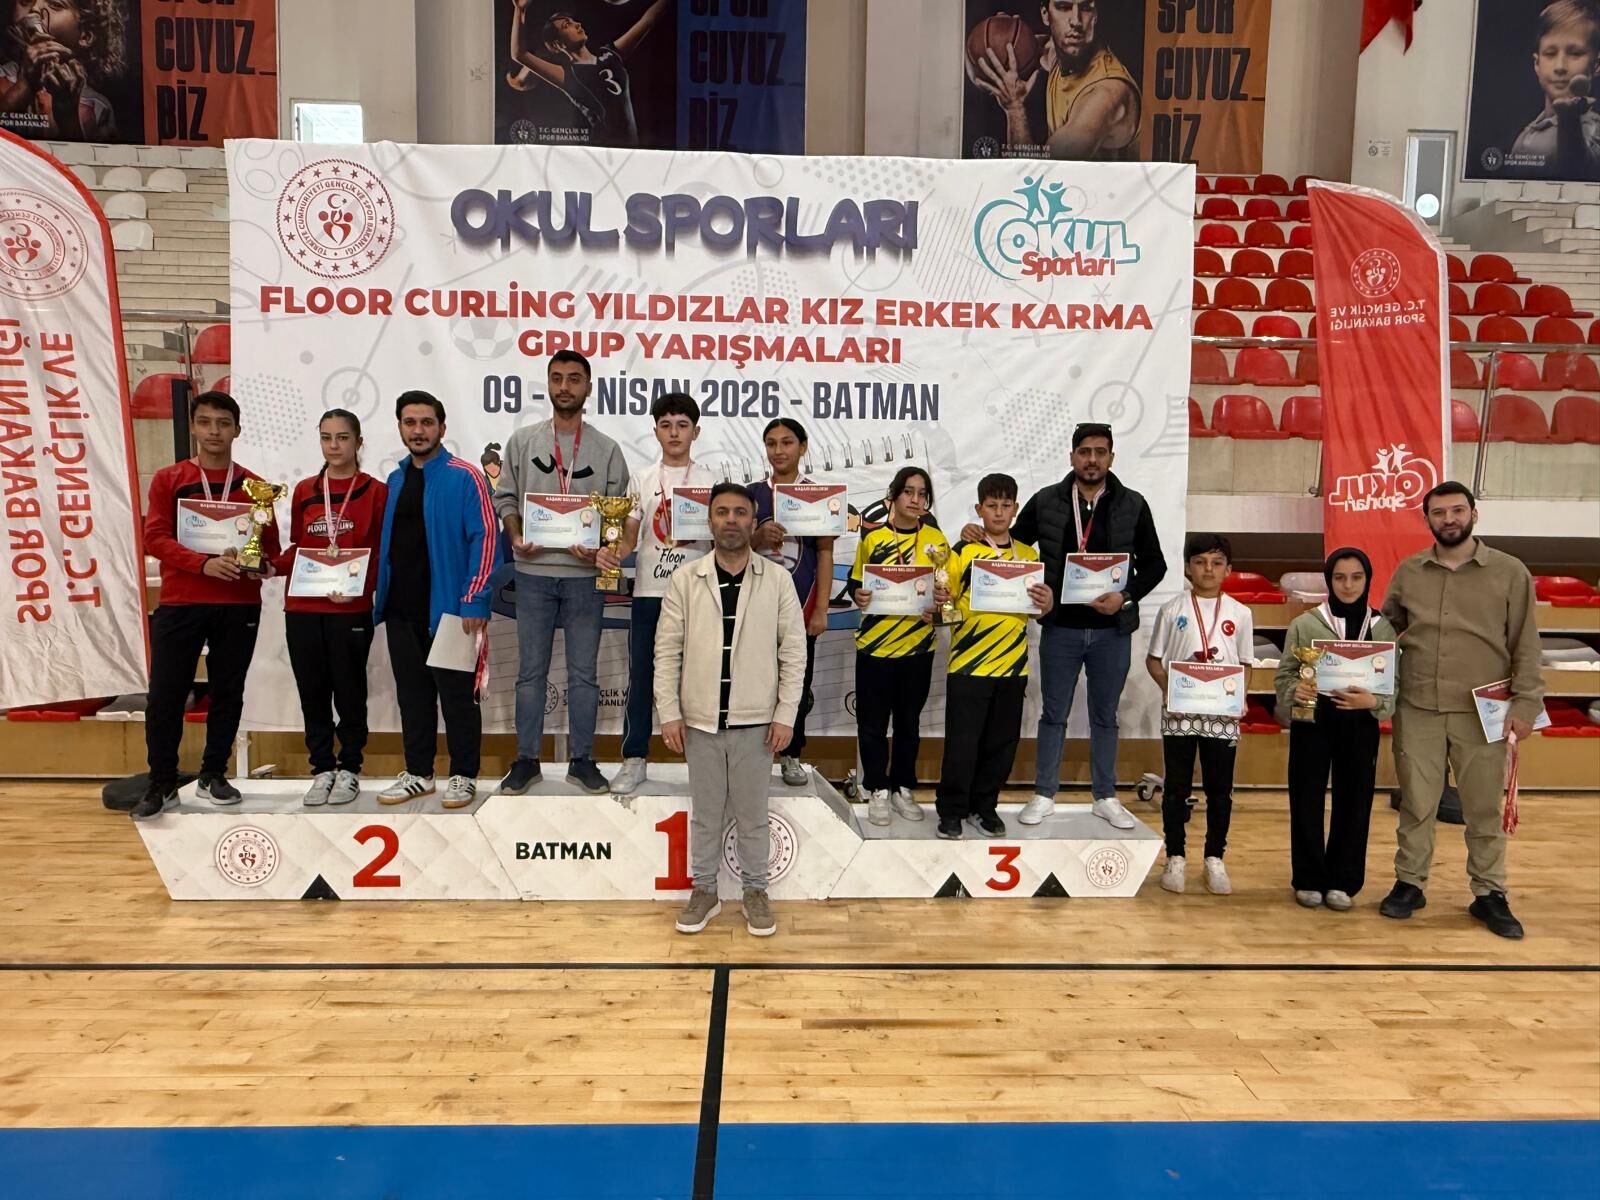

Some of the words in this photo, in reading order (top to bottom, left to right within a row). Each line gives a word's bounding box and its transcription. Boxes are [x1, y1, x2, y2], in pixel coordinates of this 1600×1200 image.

[599, 69, 622, 95] 3
[156, 79, 208, 141] BİZ
[688, 91, 738, 151] BİZ
[1152, 107, 1201, 166] BİZ
[450, 188, 620, 247] OKUL
[623, 192, 919, 254] SPORLARI
[997, 218, 1141, 264] OKUL
[1020, 251, 1116, 282] Sporları
[260, 285, 393, 316] FLOOR
[404, 281, 576, 319] CURLİNG
[587, 292, 789, 324] YILDIZLAR
[801, 297, 864, 325] KIZ
[875, 299, 1001, 328] ERKEK
[1011, 303, 1154, 330] KARMA
[518, 329, 626, 358] GRUP
[636, 331, 902, 369] YARIŞMALARI
[483, 375, 522, 413] 09
[700, 379, 780, 418] 2026
[812, 381, 940, 421] BATMAN
[660, 548, 685, 563] Floor
[600, 688, 619, 697] ÇLİK
[352, 825, 401, 888] 2
[515, 842, 612, 860] BATMAN
[655, 811, 695, 890] 1
[985, 846, 1021, 891] 3
